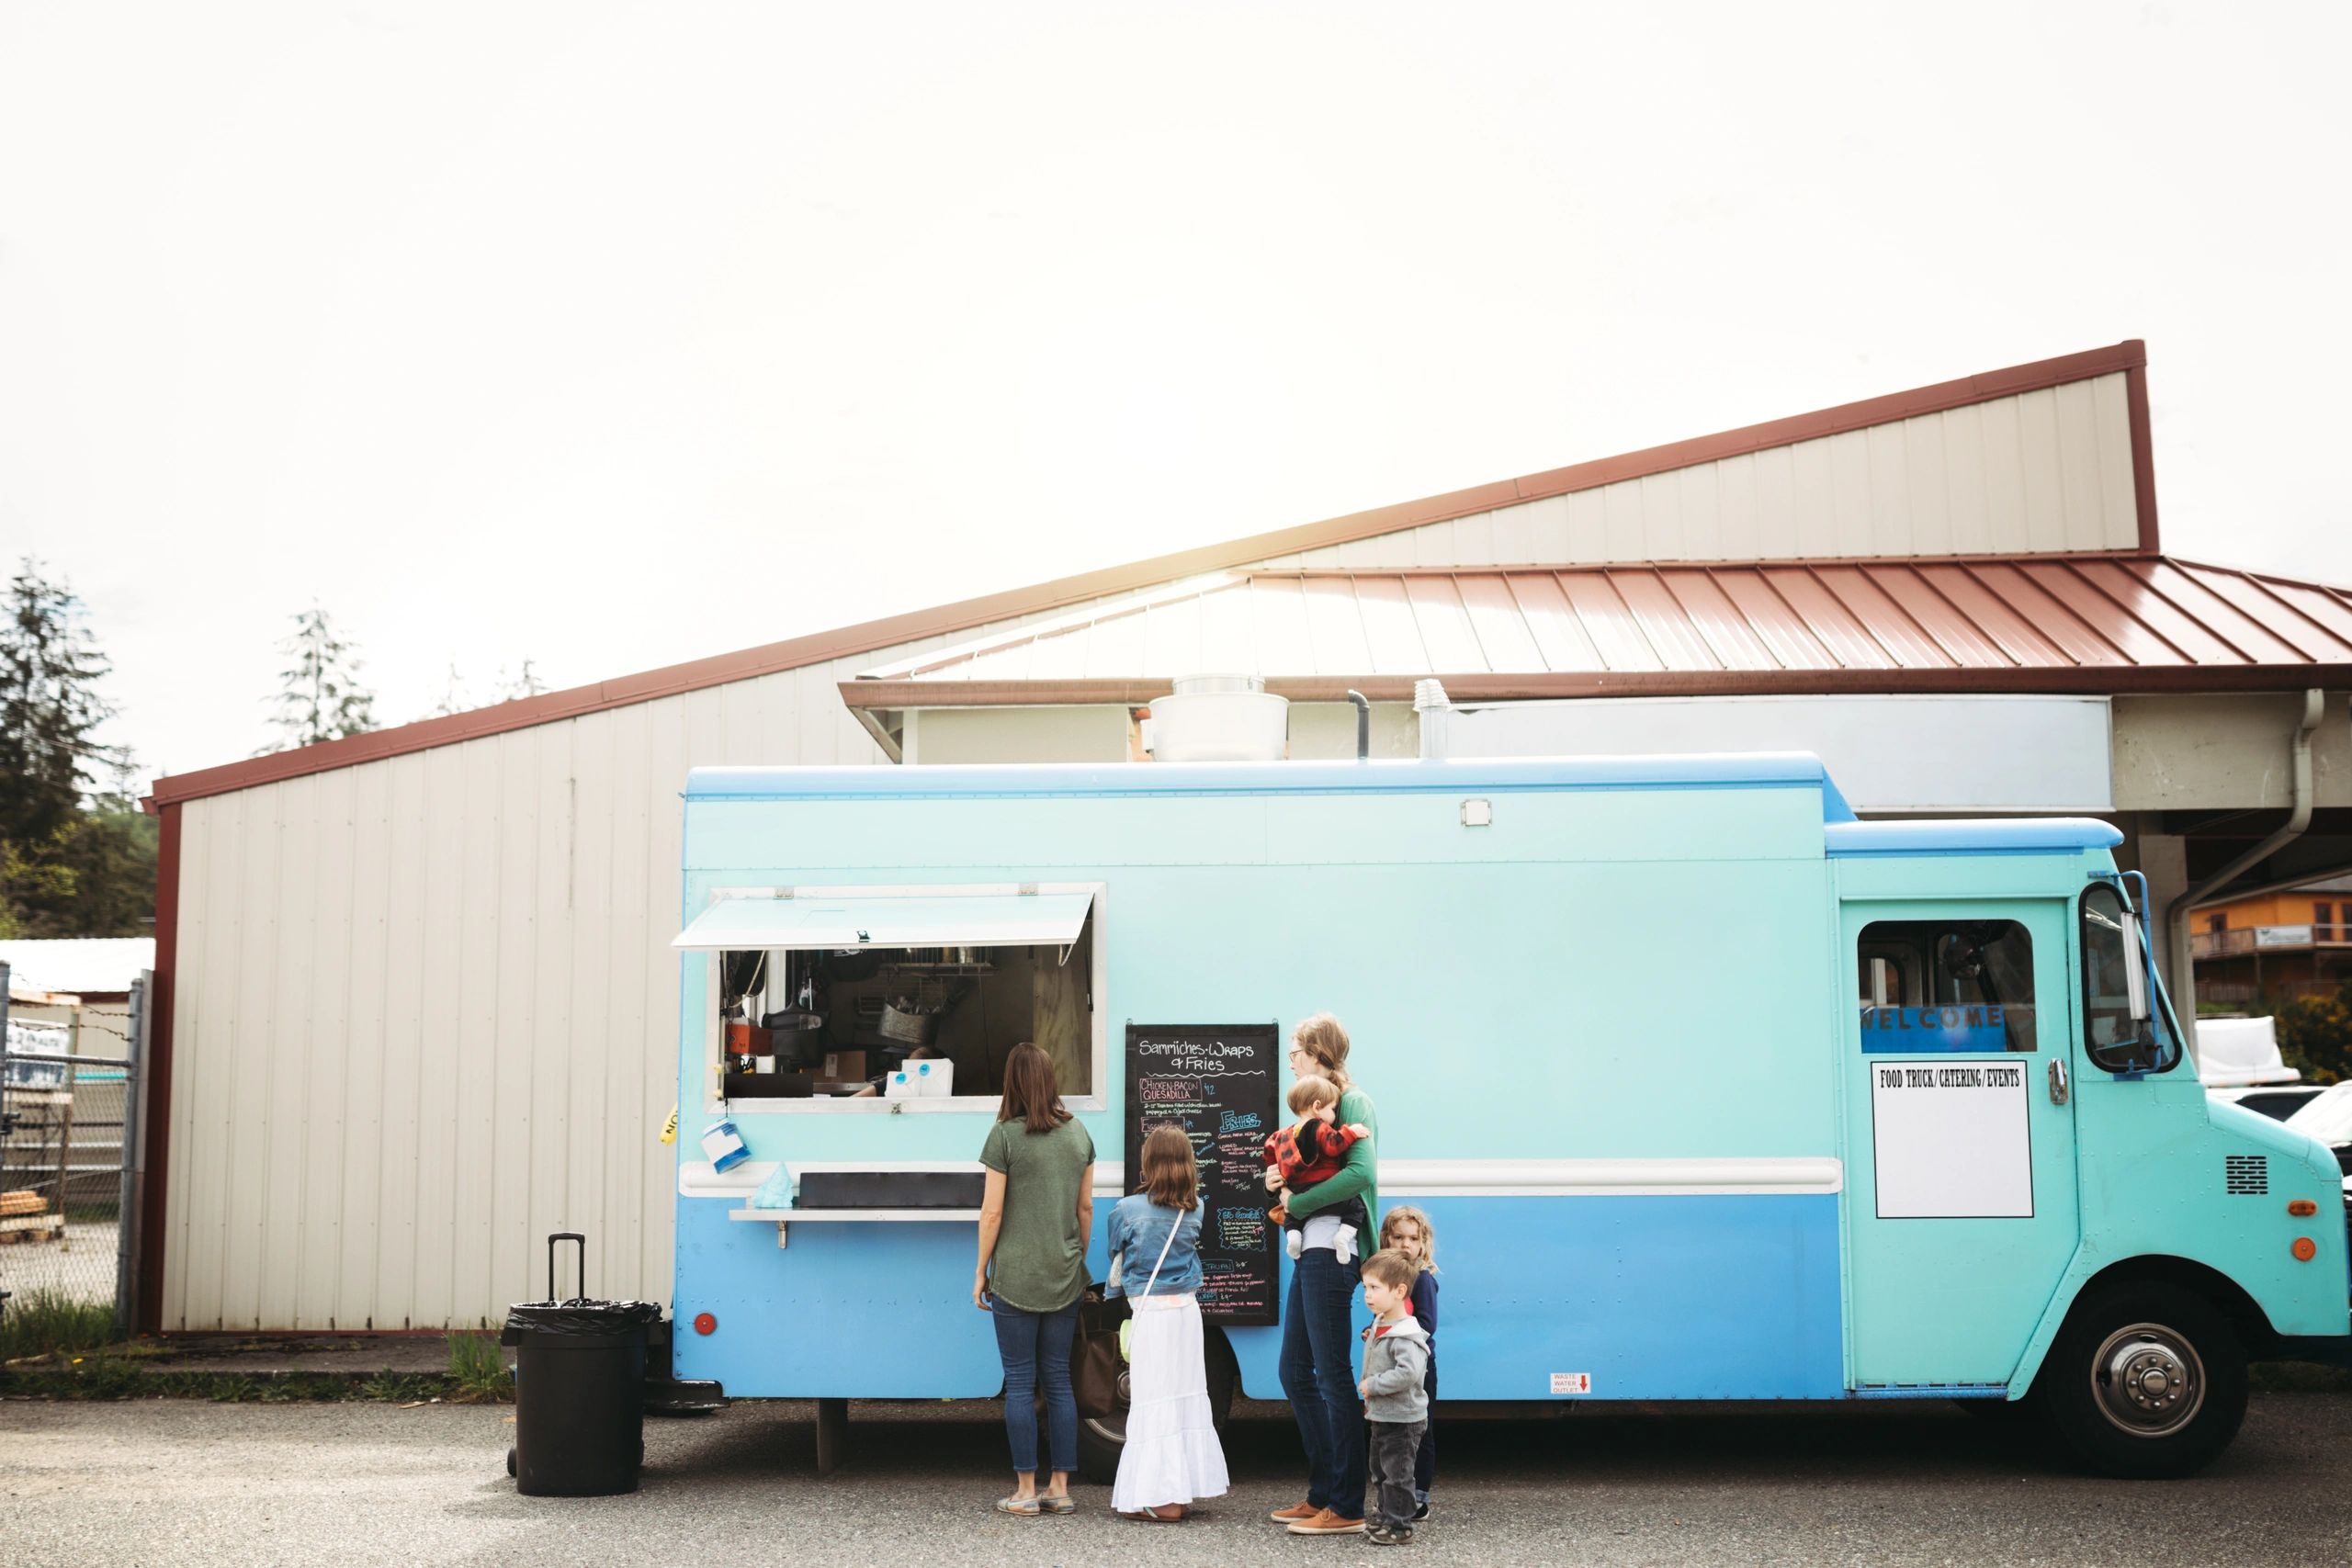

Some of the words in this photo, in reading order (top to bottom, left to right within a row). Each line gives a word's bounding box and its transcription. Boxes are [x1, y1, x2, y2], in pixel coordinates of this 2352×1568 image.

[1860, 1007, 2000, 1030] WELCOME
[1880, 1069, 1903, 1089] FOOD
[1143, 1090, 1191, 1100] QUESADILLA
